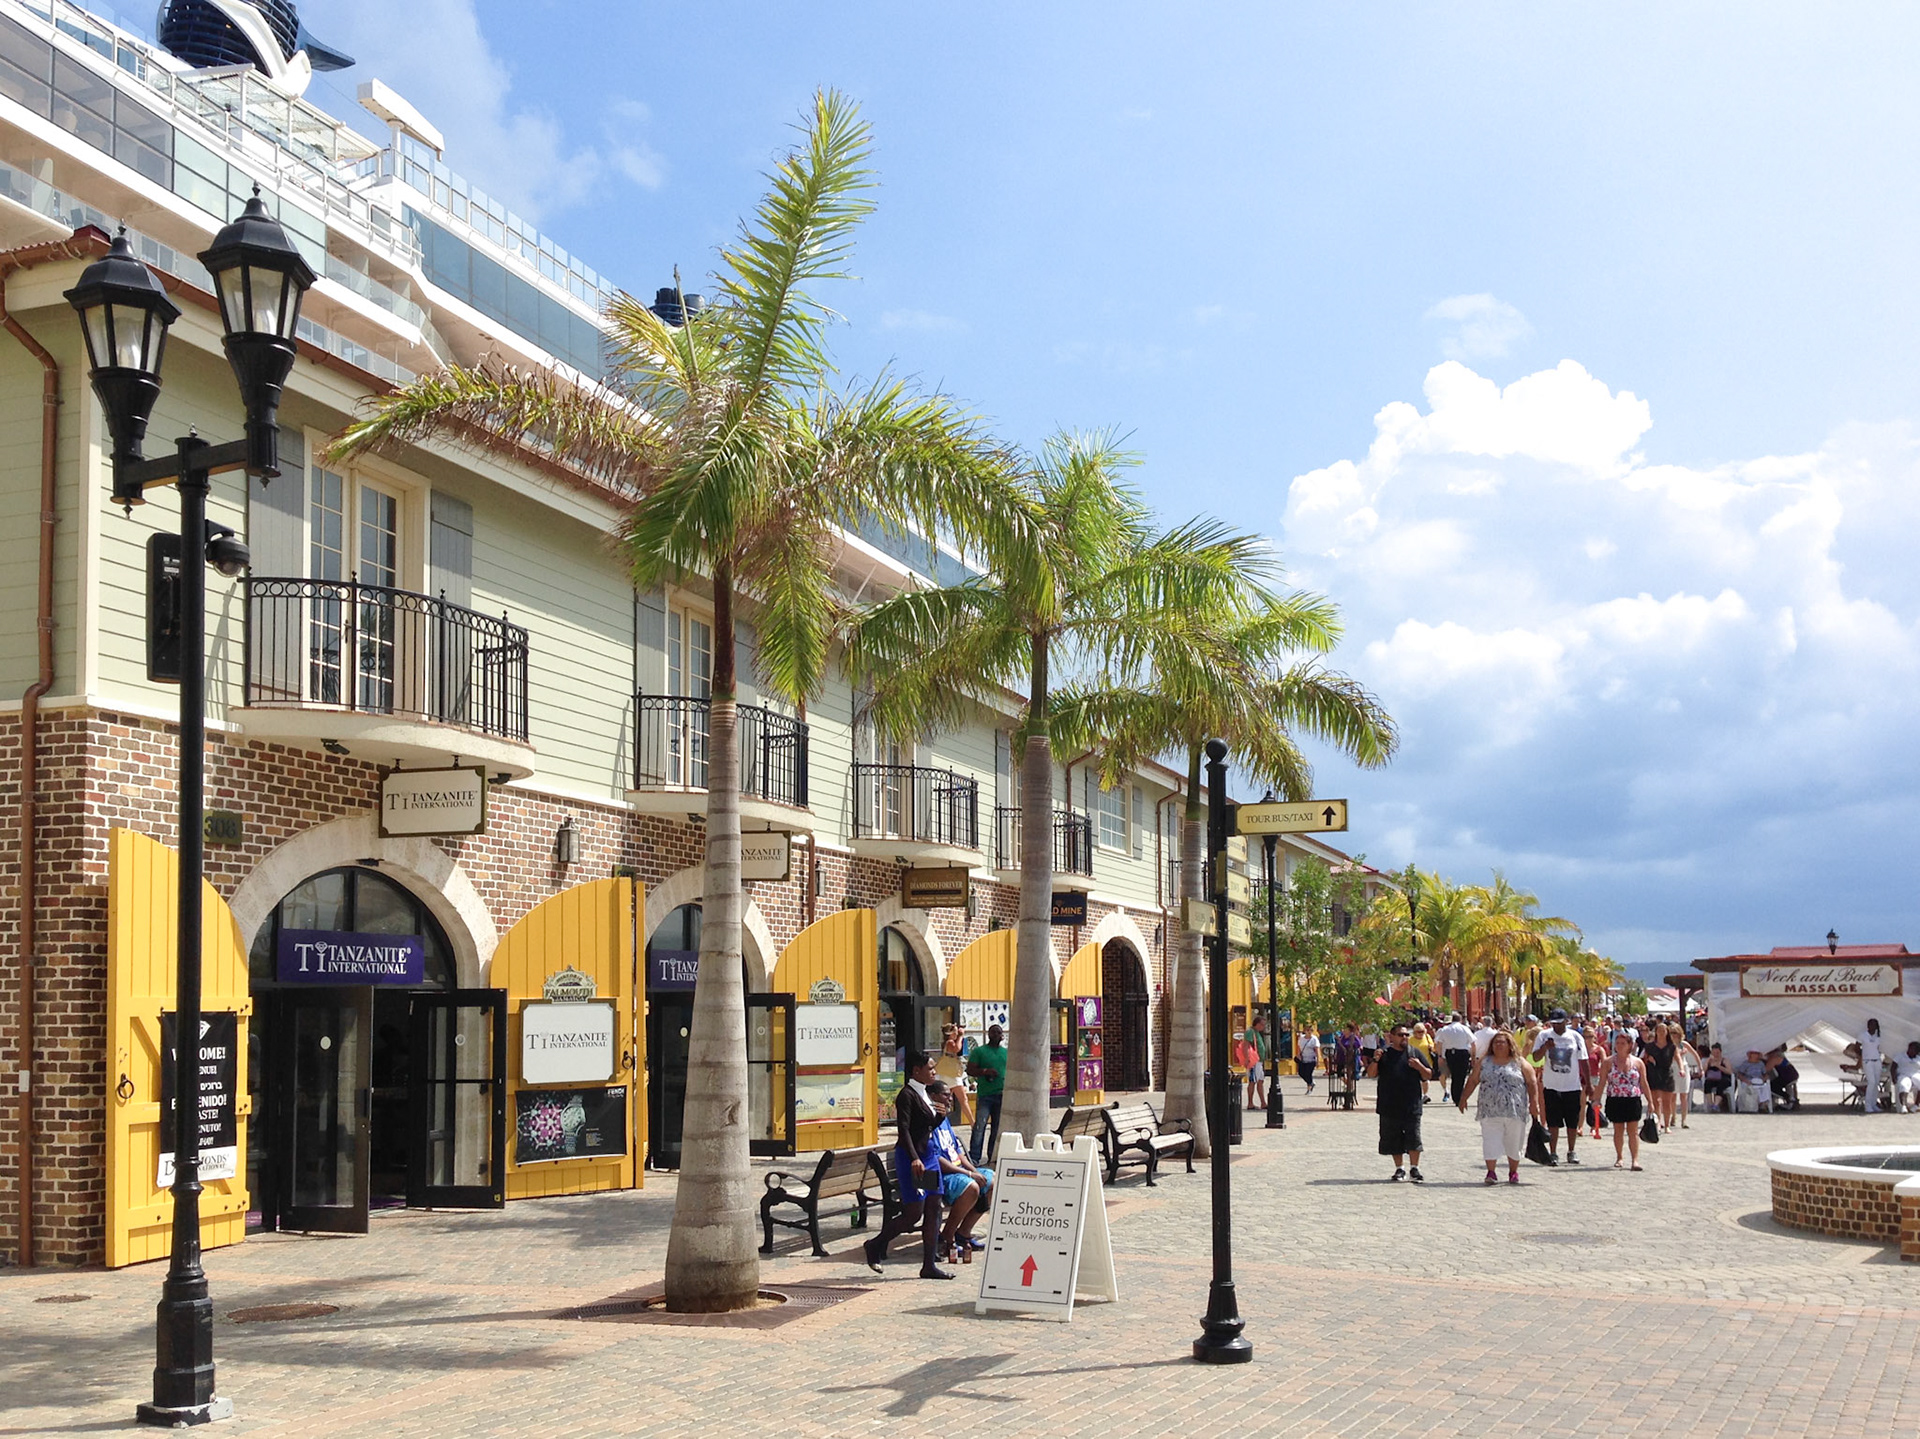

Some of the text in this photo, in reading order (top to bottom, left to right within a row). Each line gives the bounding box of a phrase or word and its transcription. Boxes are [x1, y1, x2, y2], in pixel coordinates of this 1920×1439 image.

[412, 791, 476, 802] TANZANITE
[411, 800, 475, 809] INTERNATIONAL
[1246, 812, 1314, 824] TOUR BUS/TAXI
[204, 816, 237, 839] 308
[741, 848, 783, 856] ANZANITE
[909, 880, 963, 889] DIAMONDS FOREVER
[1060, 906, 1083, 915] MINE
[328, 961, 407, 975] INTERNATIONAL
[1757, 967, 1884, 984] Neck and Back
[545, 987, 593, 997] FALMOUTH
[1784, 984, 1858, 993] MASSAGE
[810, 992, 844, 1000] FALMOUTH
[550, 1032, 608, 1042] TANZANITE
[550, 1041, 607, 1049] INTERNATIONAL
[1018, 1201, 1055, 1217] Shore
[1000, 1211, 1070, 1229] Excursions
[1004, 1230, 1062, 1242] This Way Please
